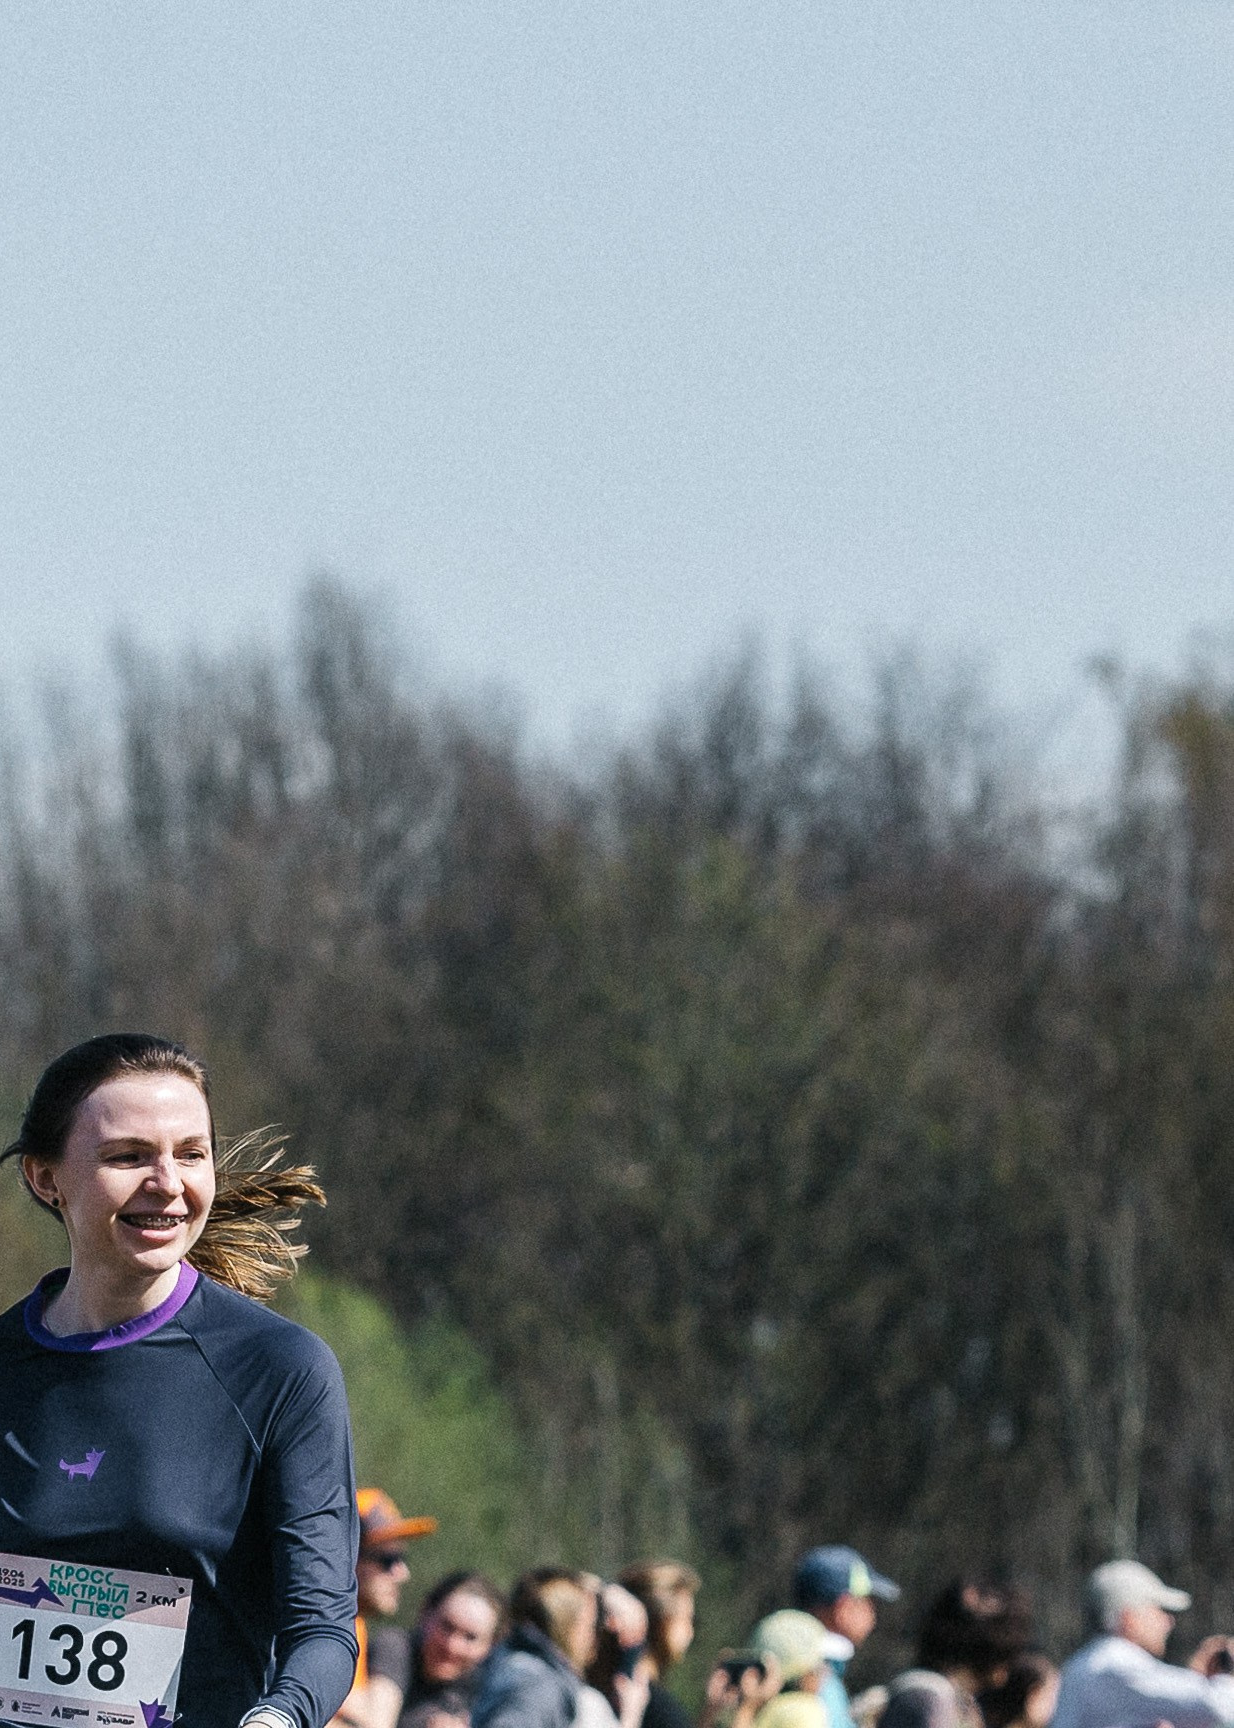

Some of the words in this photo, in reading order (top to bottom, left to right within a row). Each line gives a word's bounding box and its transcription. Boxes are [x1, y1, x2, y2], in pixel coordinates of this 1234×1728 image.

[49, 1563, 115, 1586] КРОСС
[48, 1579, 130, 1605] БЫСТРЫЙ
[135, 1590, 148, 1604] 2
[11, 1618, 128, 1692] 138
